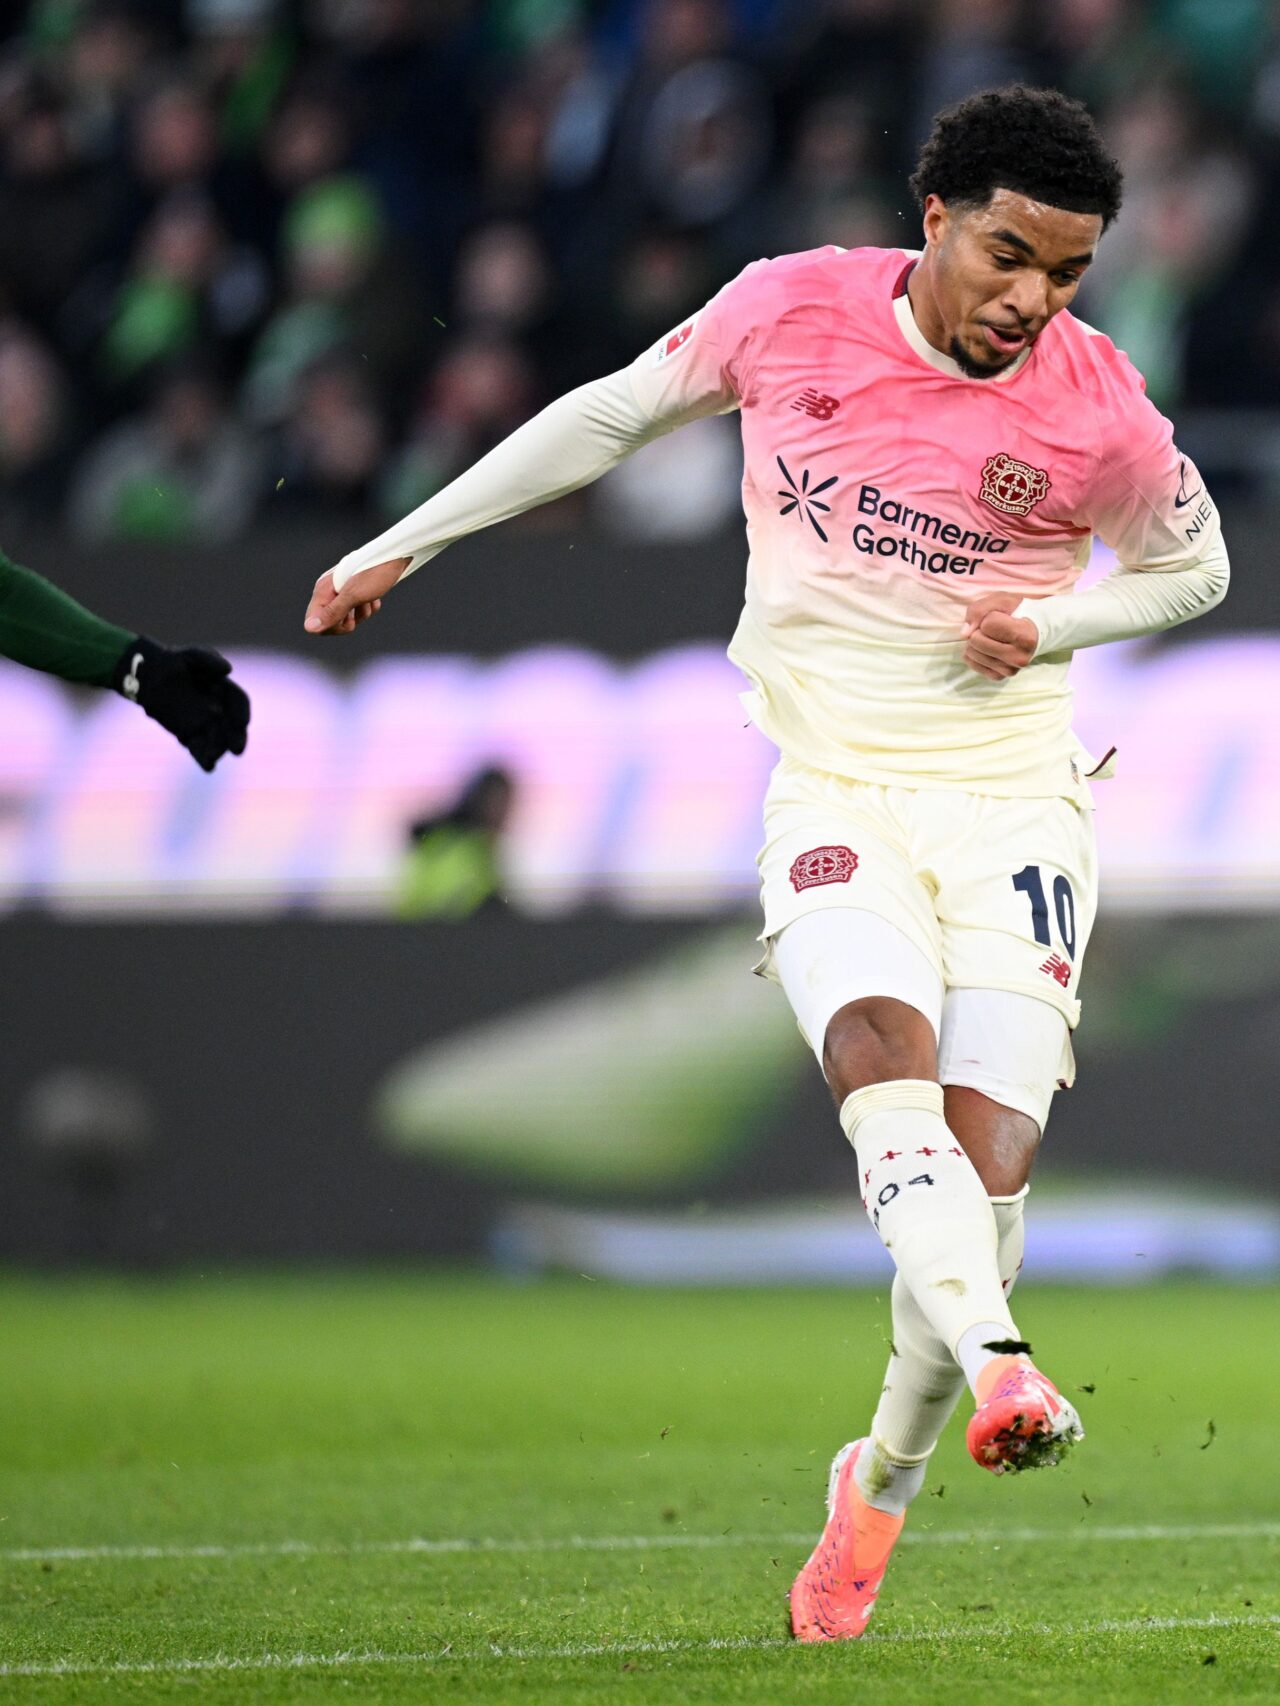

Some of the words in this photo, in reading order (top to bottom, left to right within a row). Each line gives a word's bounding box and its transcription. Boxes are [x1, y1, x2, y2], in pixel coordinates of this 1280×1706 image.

[857, 484, 1010, 554] Barmenia
[984, 491, 1025, 512] Leverkusen
[853, 523, 984, 576] Gothaer
[1012, 865, 1076, 962] 10
